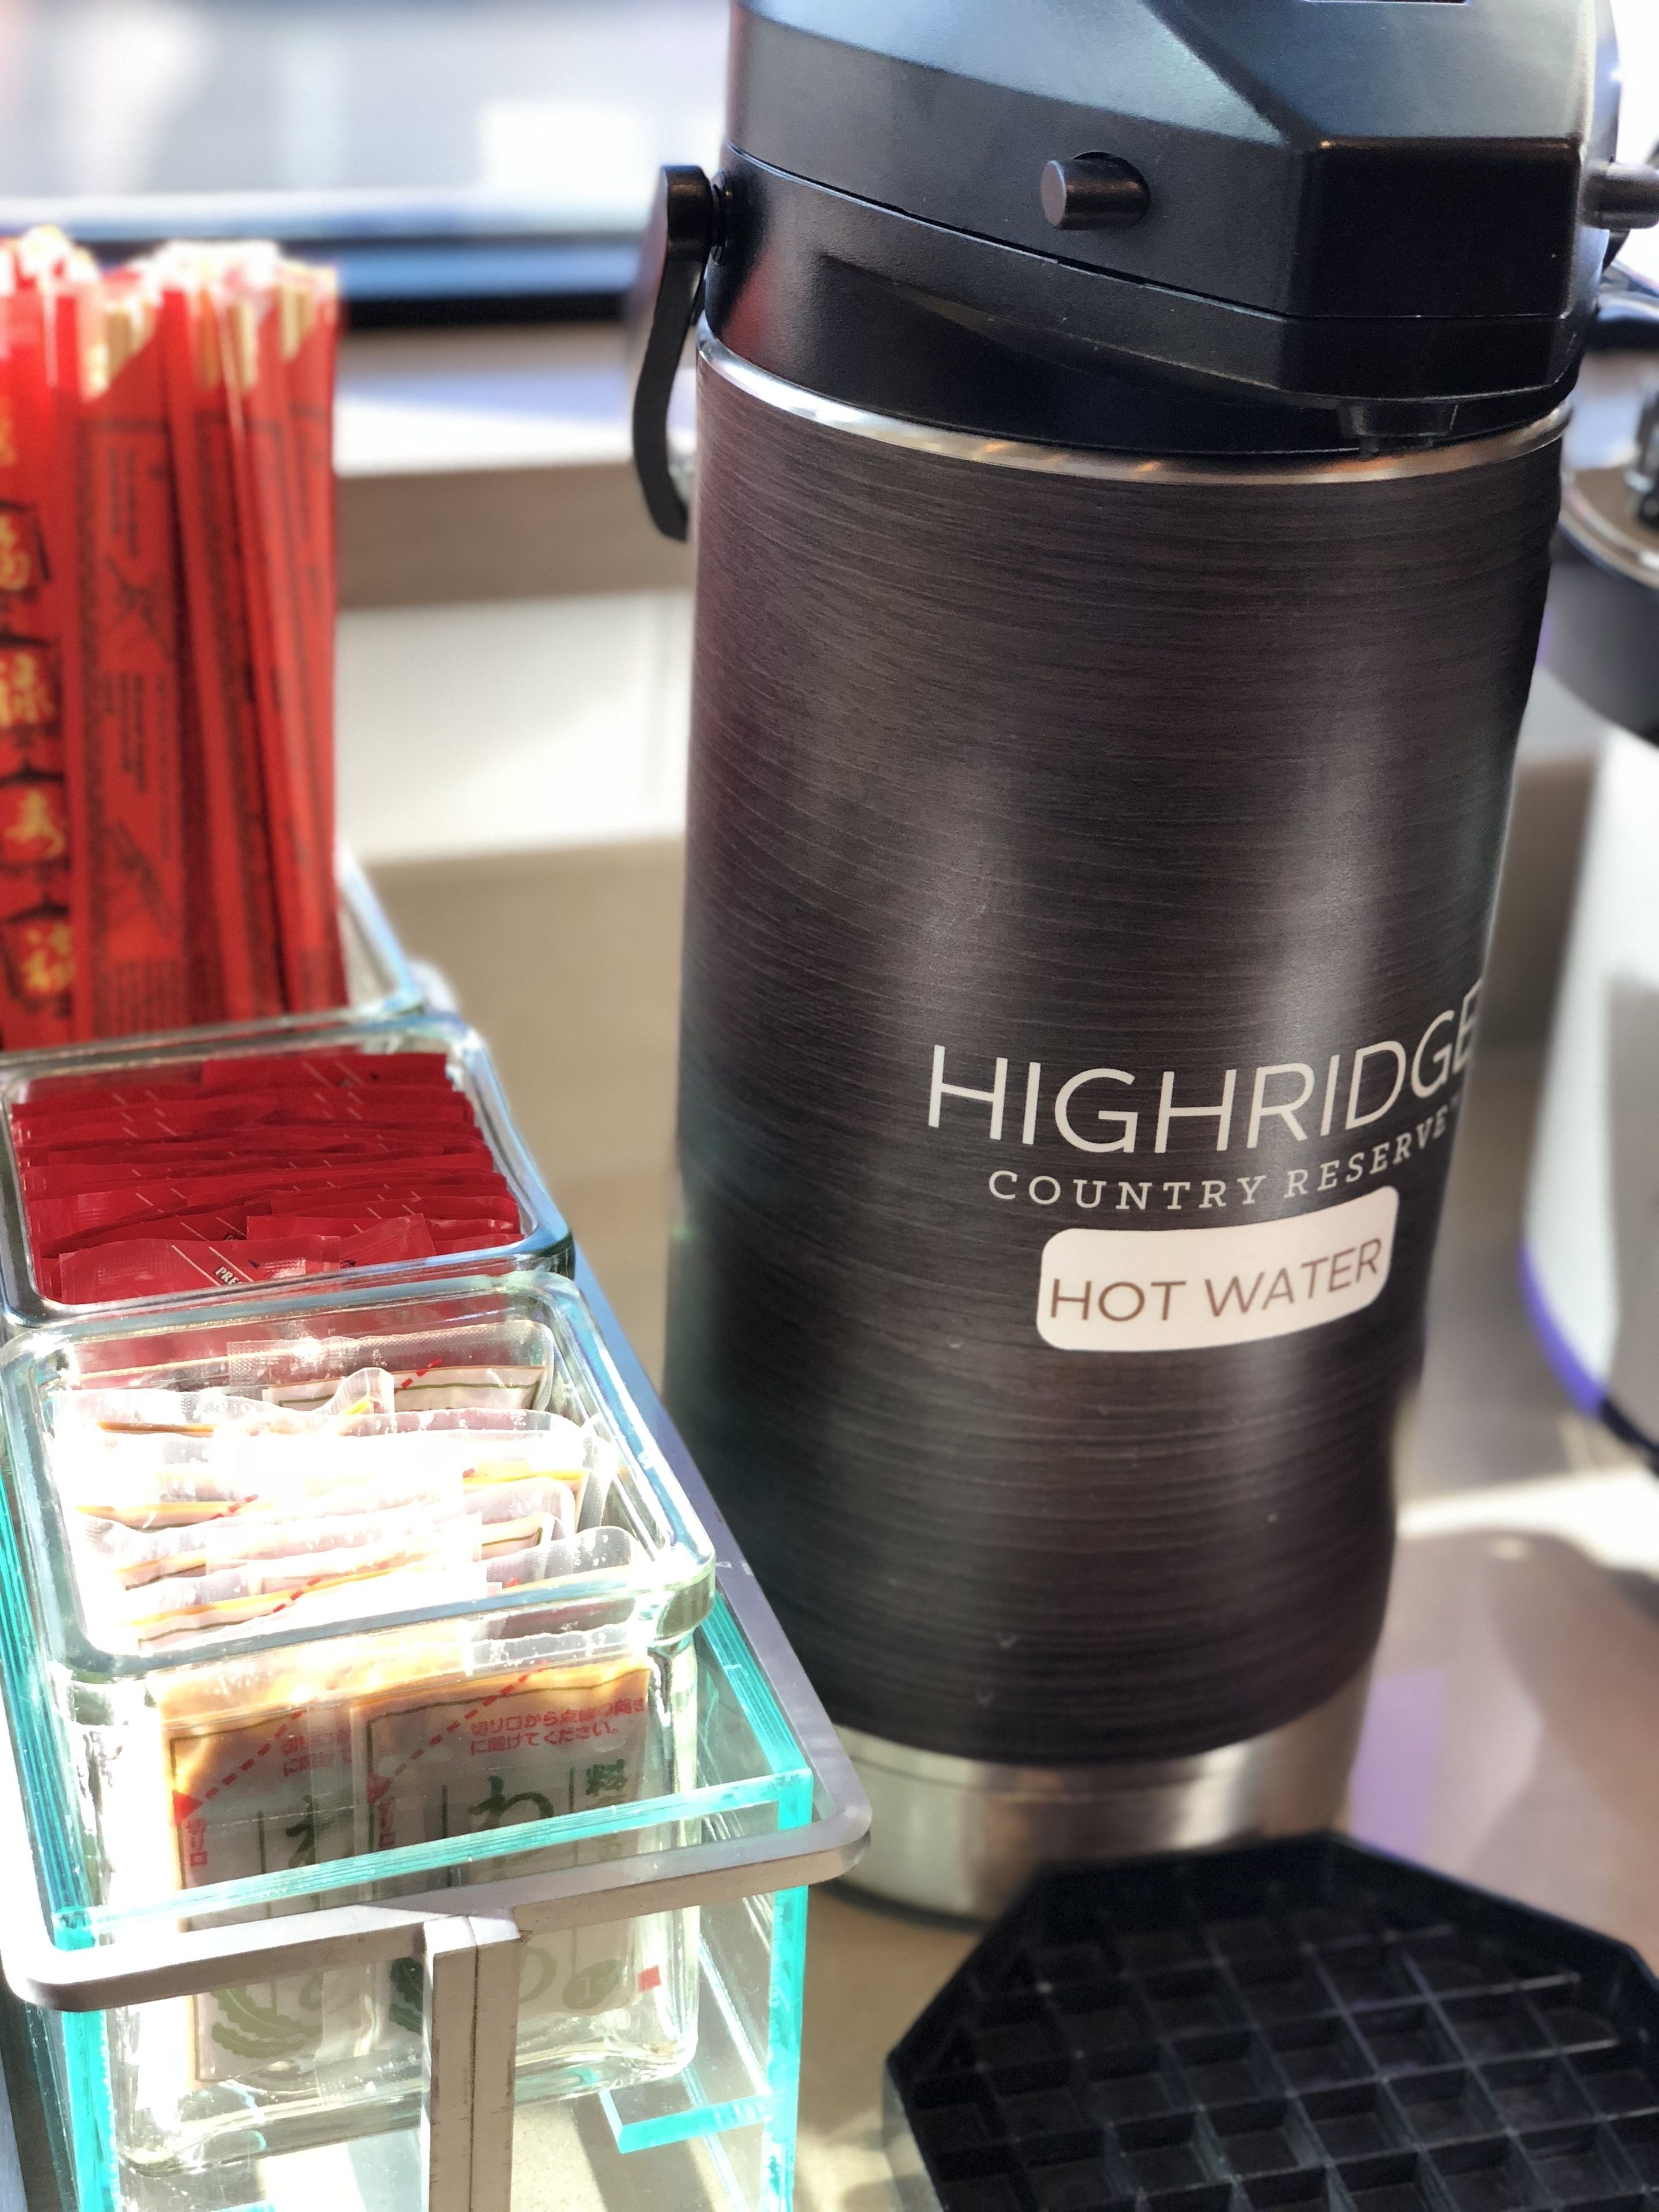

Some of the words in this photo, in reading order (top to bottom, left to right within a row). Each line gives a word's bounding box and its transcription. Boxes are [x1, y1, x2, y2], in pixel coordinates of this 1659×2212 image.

[928, 978, 1482, 1153] HIGHRIDGE
[988, 1170, 1265, 1210] COUNTRY
[1285, 1104, 1448, 1198] RESERVE
[214, 1266, 245, 1285] PRE
[1050, 1278, 1187, 1321] HOT
[1205, 1237, 1383, 1317] WATER
